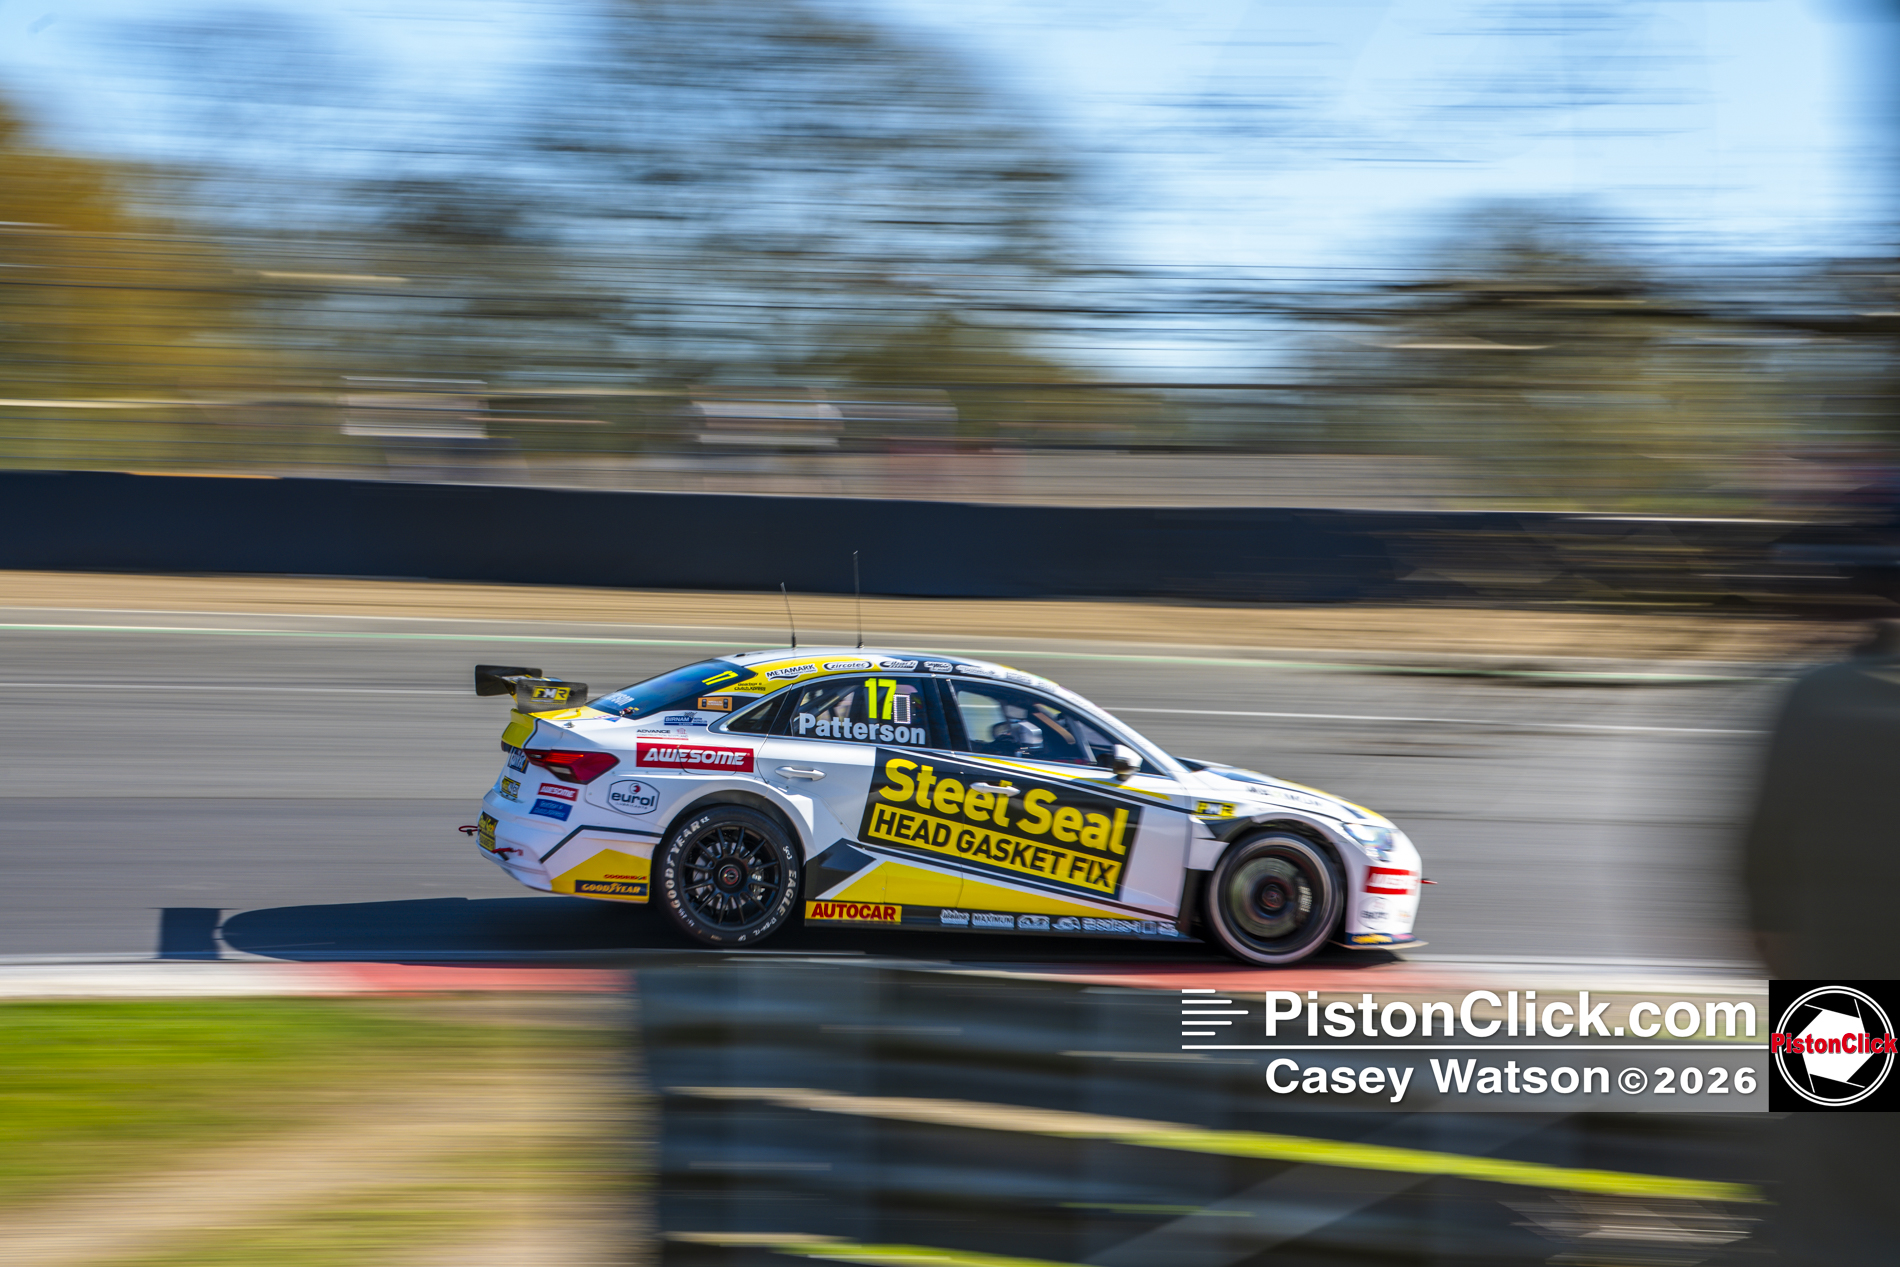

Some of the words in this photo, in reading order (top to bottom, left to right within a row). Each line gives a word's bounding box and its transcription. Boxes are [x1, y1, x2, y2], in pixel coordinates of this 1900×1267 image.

[766, 664, 815, 677] METAMARK
[831, 661, 866, 669] zircotec
[701, 670, 739, 686] 17
[864, 678, 897, 721] 17
[799, 712, 926, 745] Patterson
[643, 748, 747, 766] AWESOME
[611, 792, 656, 807] eurol
[878, 758, 1013, 827] Steel
[1015, 788, 1130, 856] Seal
[874, 808, 951, 847] HEAD
[956, 829, 1067, 872] GASKET
[1068, 858, 1116, 888] FIX
[581, 882, 642, 894] GOODYEAR
[778, 869, 797, 917] EAGLE
[811, 903, 897, 921] AUTOCAR
